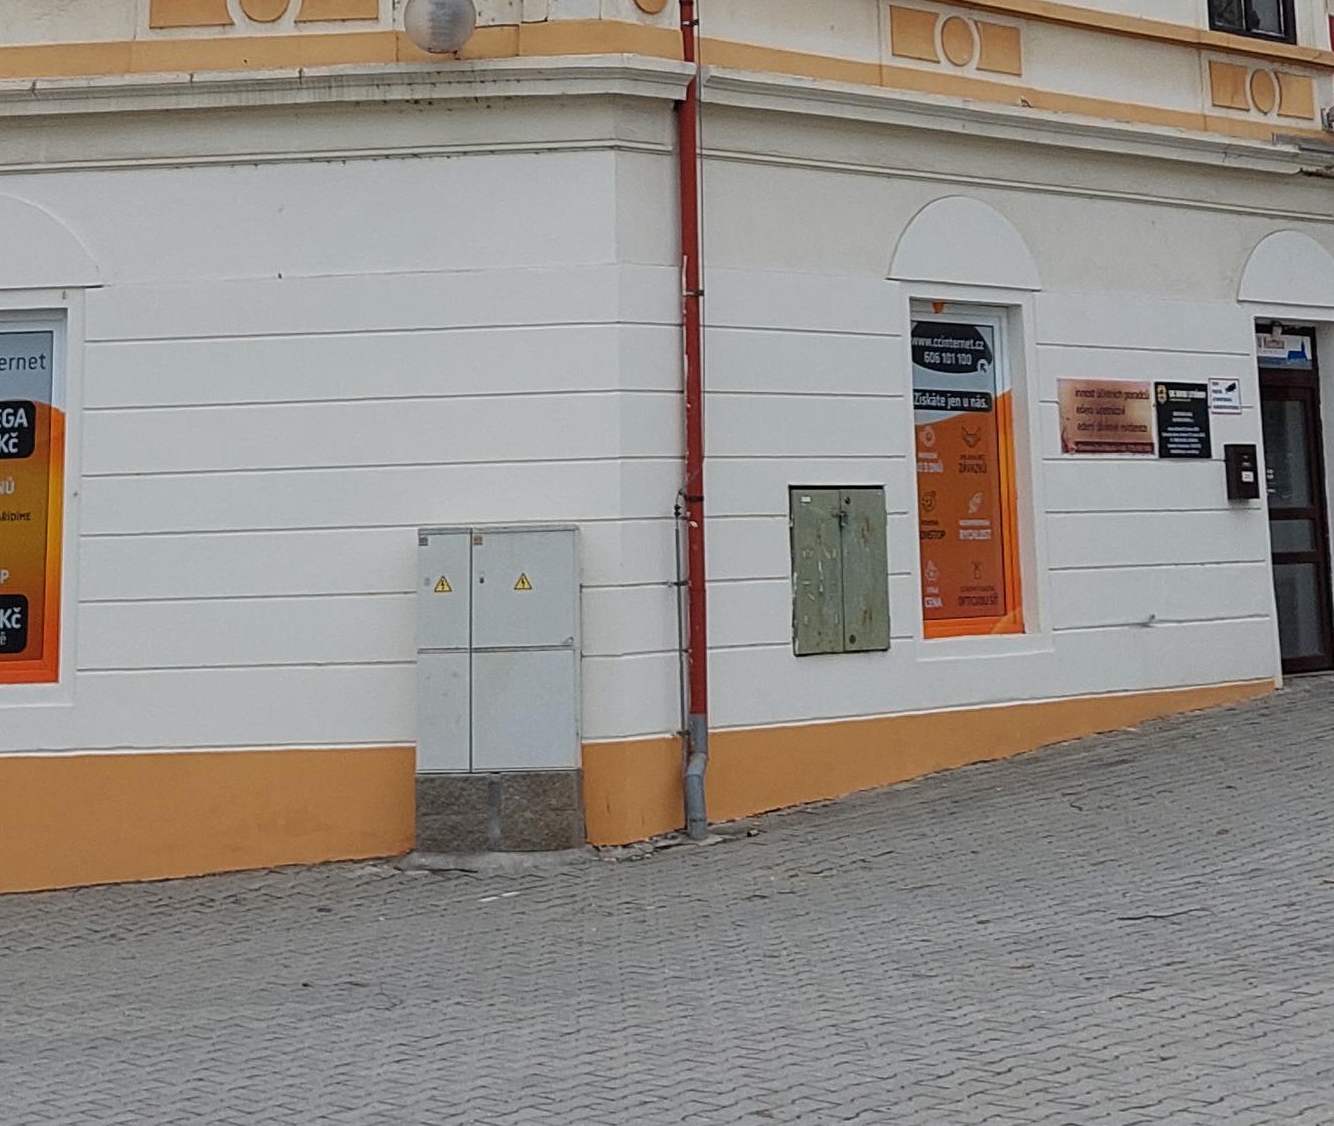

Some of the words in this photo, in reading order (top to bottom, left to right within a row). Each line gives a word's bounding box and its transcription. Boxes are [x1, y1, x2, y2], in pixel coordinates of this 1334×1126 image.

[912, 335, 985, 350] www.ccinternet.cz
[947, 394, 961, 410] jen
[962, 396, 970, 408] u
